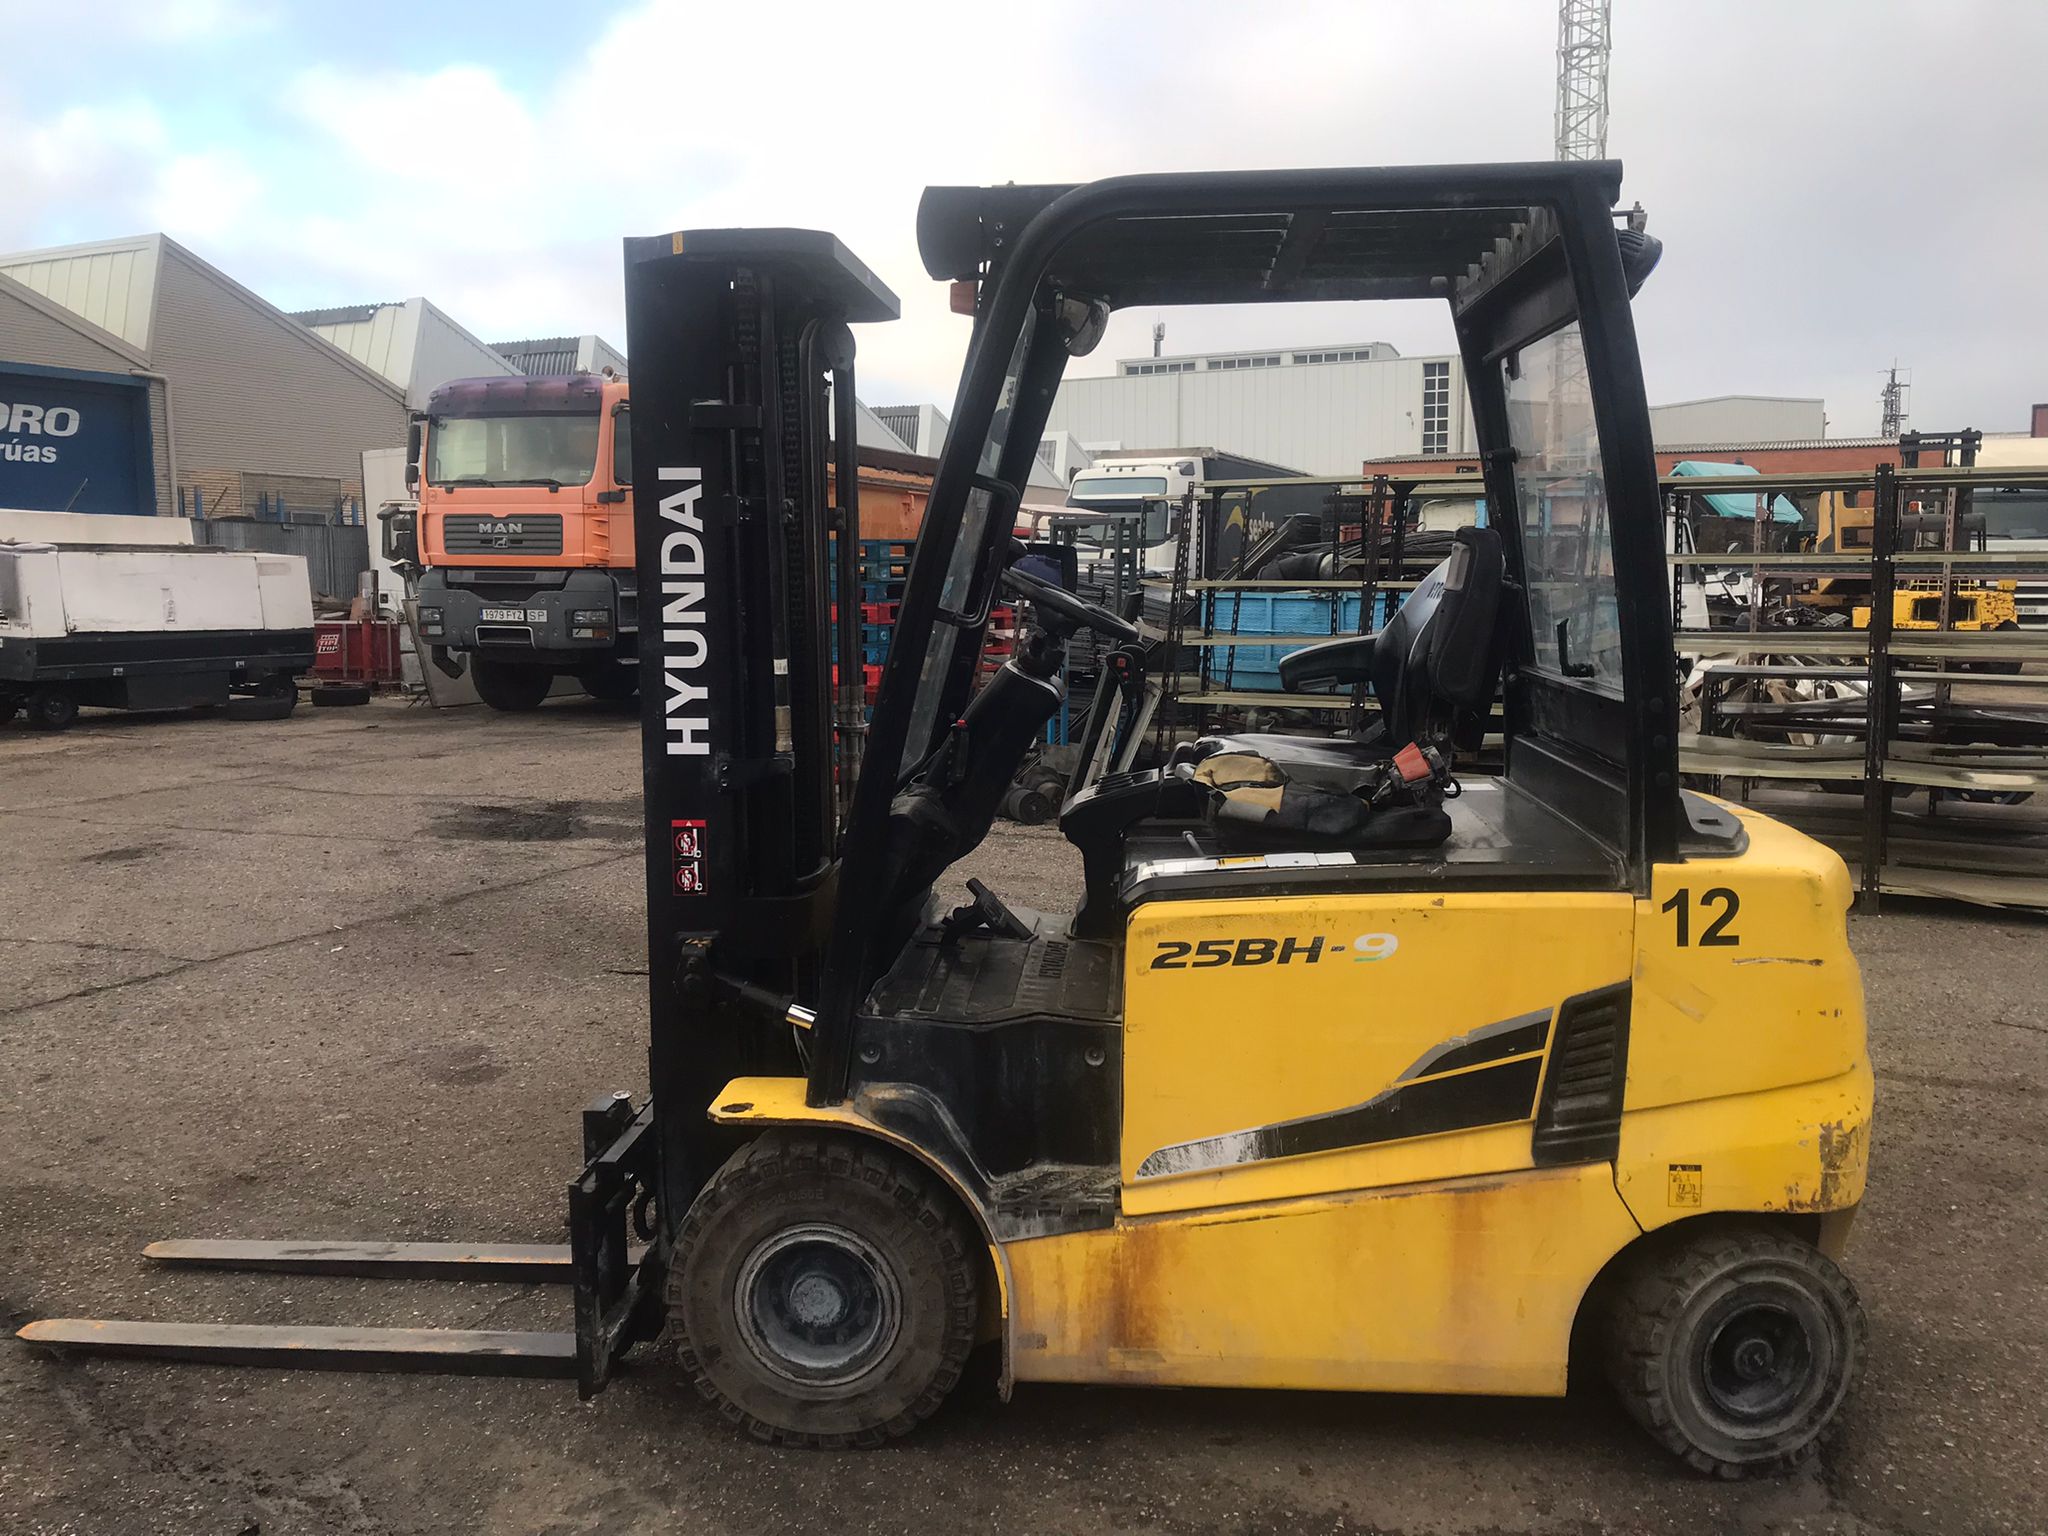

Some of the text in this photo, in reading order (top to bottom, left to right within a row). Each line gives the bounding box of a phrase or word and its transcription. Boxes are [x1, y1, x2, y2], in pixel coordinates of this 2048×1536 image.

[0, 402, 80, 437] RO
[478, 523, 523, 534] MAN
[485, 610, 523, 620] 1979 FYZ
[529, 610, 545, 621] SP
[658, 467, 710, 755] HYUNDAI
[1661, 887, 1740, 948] 12
[1150, 932, 1399, 970] 25BH-9
